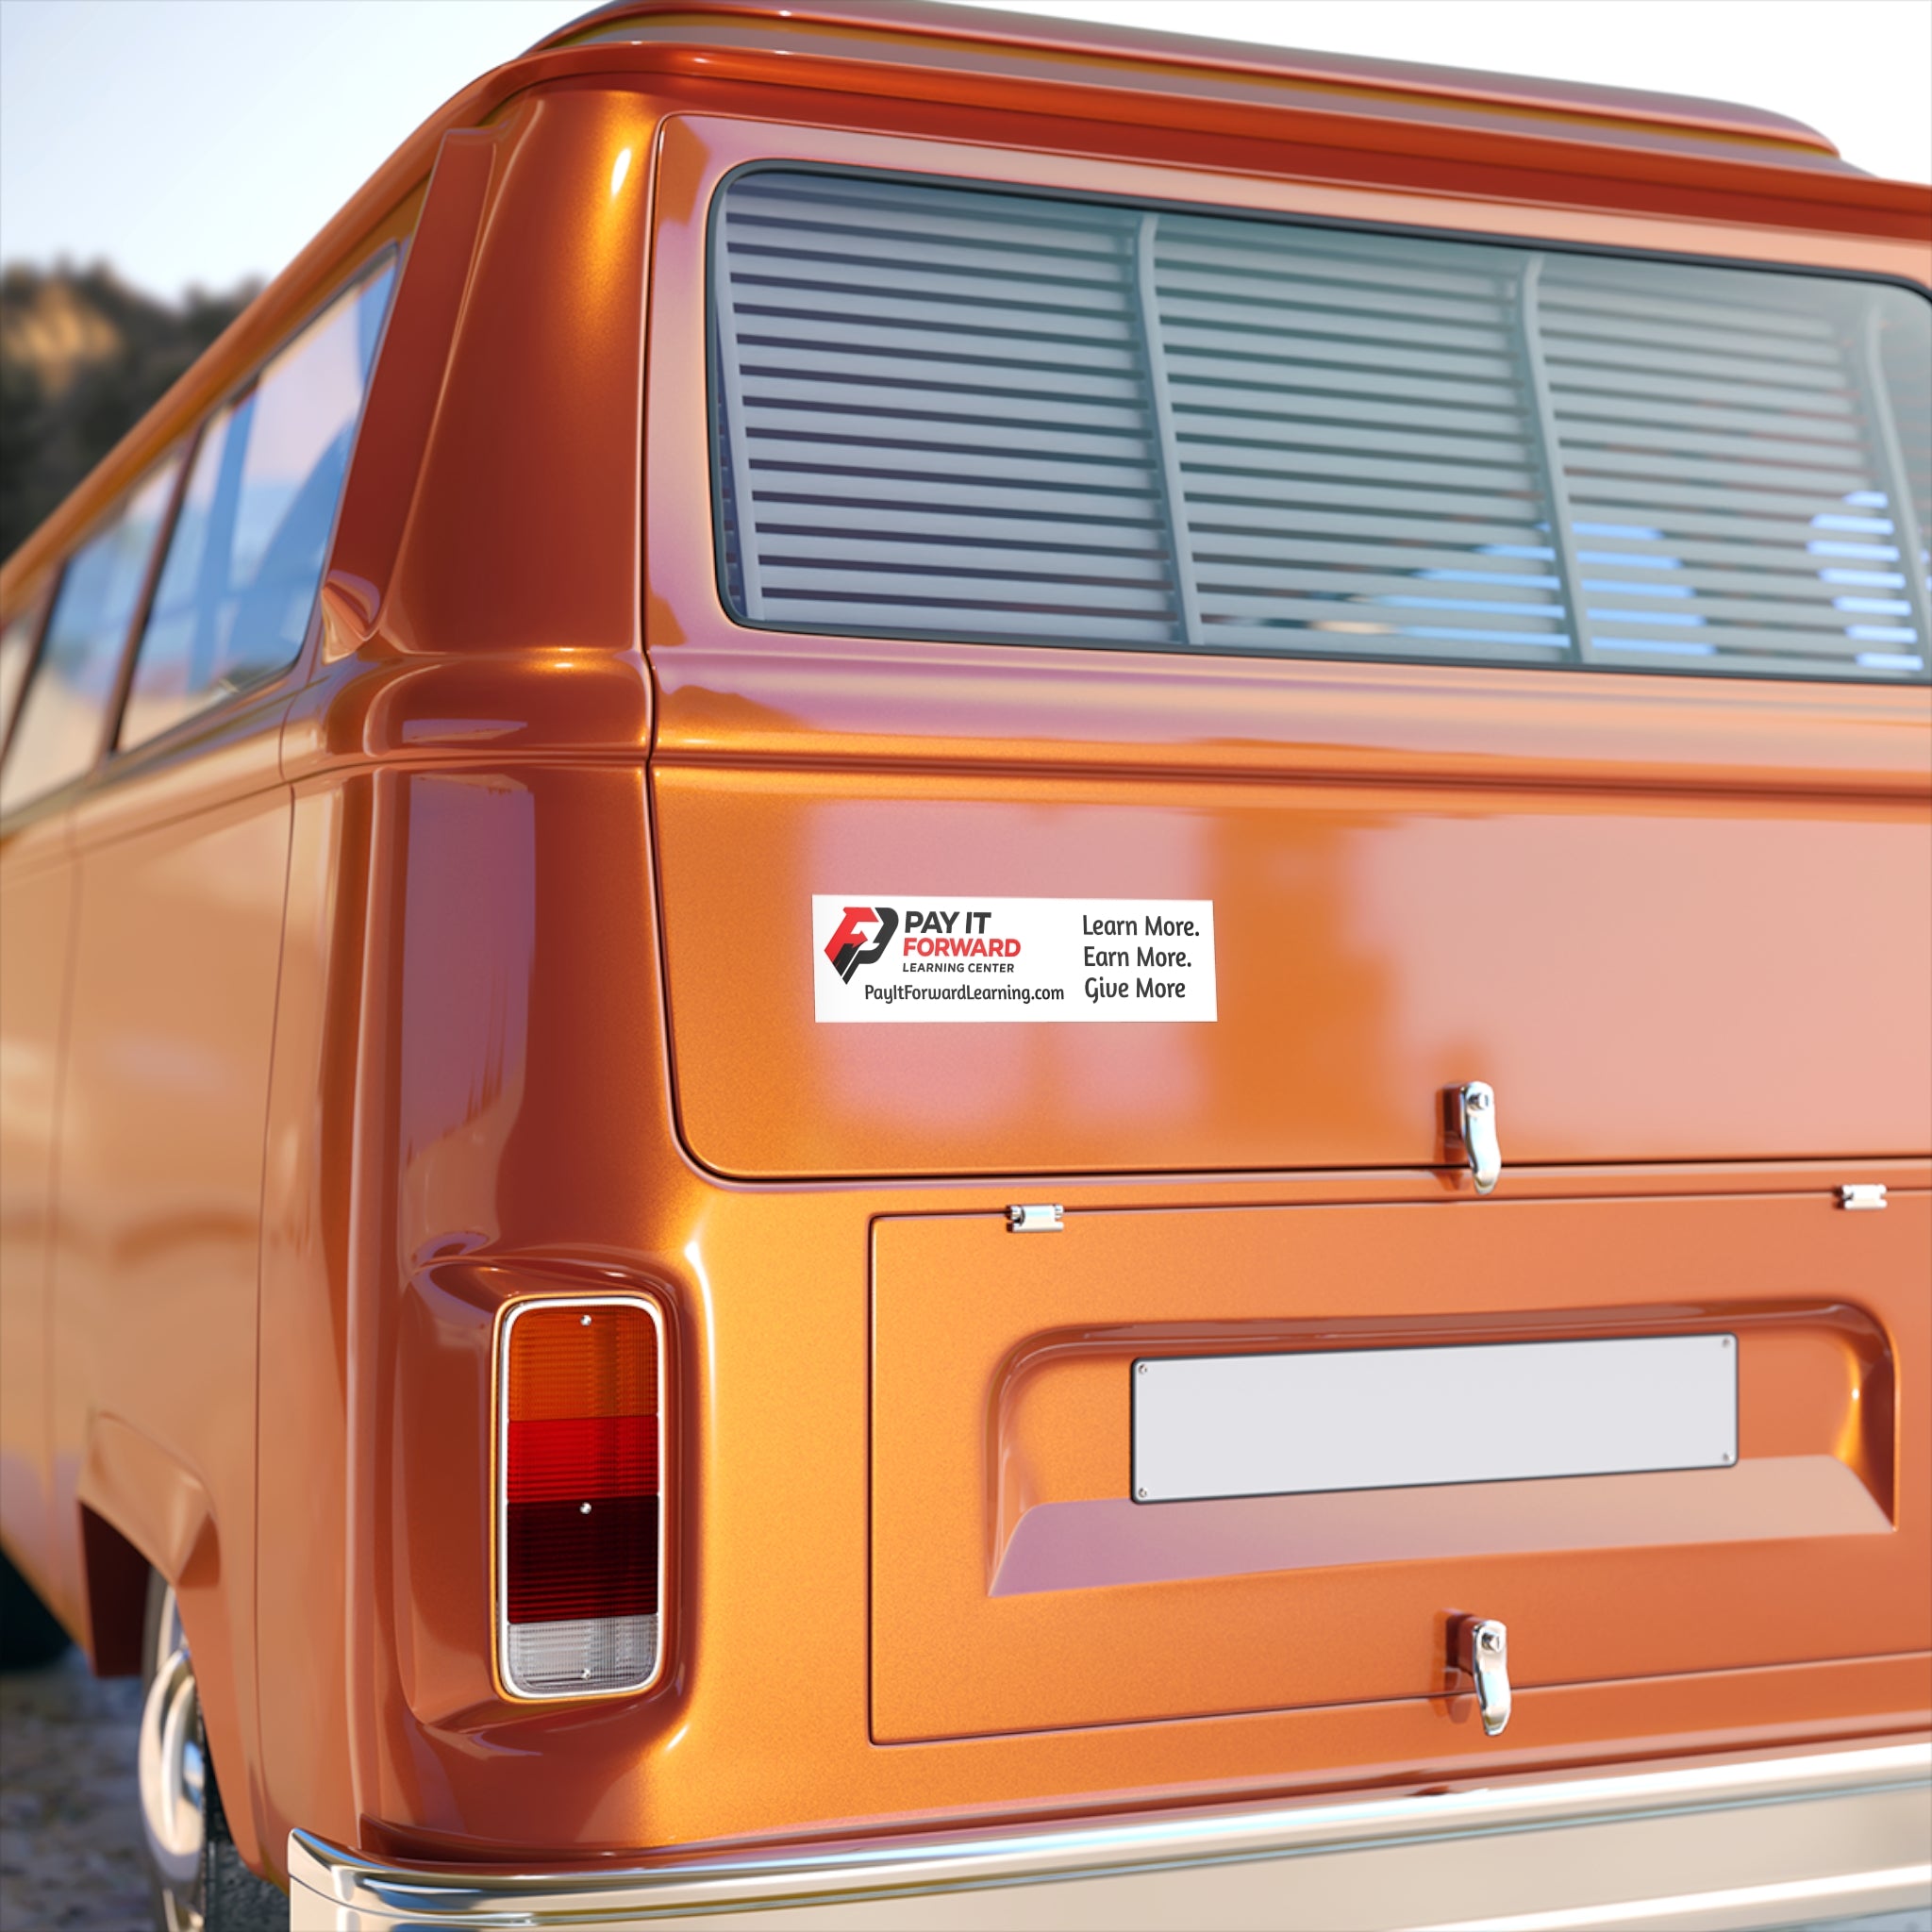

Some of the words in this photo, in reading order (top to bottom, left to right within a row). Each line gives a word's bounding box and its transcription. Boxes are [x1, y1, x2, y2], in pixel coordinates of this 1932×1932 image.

[905, 910, 960, 934] PAY
[965, 911, 992, 935] IT
[1082, 914, 1138, 937] Learn
[1145, 915, 1200, 937] More.
[903, 937, 1022, 958] FORWARD
[1084, 945, 1129, 968] Earn
[1137, 946, 1192, 968] More.
[902, 962, 965, 974] LEARNING
[967, 962, 1015, 974] CENTER
[864, 984, 1065, 1005] PayItForwardLearning.com
[1084, 975, 1129, 1004] Give
[1136, 977, 1186, 998] More
